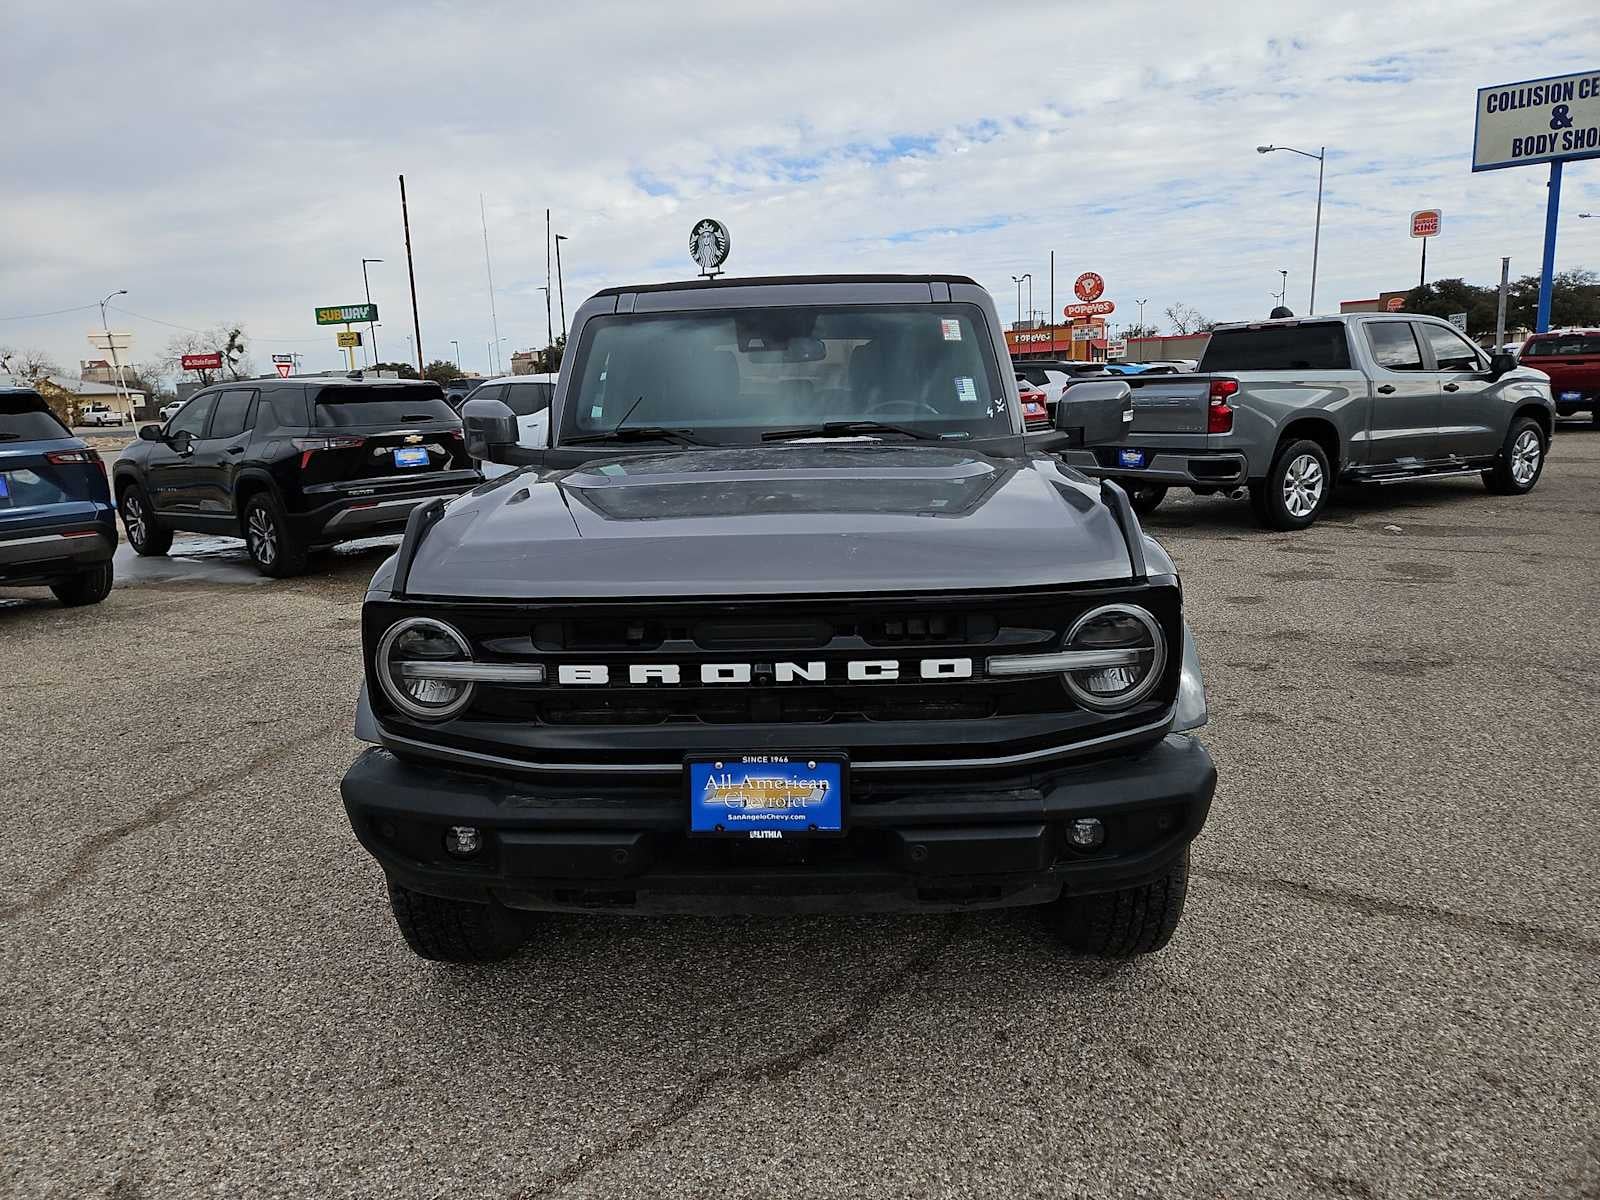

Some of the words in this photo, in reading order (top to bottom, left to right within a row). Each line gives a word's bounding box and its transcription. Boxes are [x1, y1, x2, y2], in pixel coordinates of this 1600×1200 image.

[1487, 80, 1574, 114] COLLISION
[1550, 104, 1573, 130] &
[1512, 132, 1558, 157] BODY
[1562, 127, 1600, 151] SHO
[1414, 223, 1438, 231] KING
[319, 306, 369, 321] SUBWAY
[558, 658, 972, 684] BRONCO
[704, 774, 732, 790] All
[742, 775, 831, 790] American
[724, 791, 808, 809] Chevrolet
[727, 813, 806, 821] SanAngeloChevy.com
